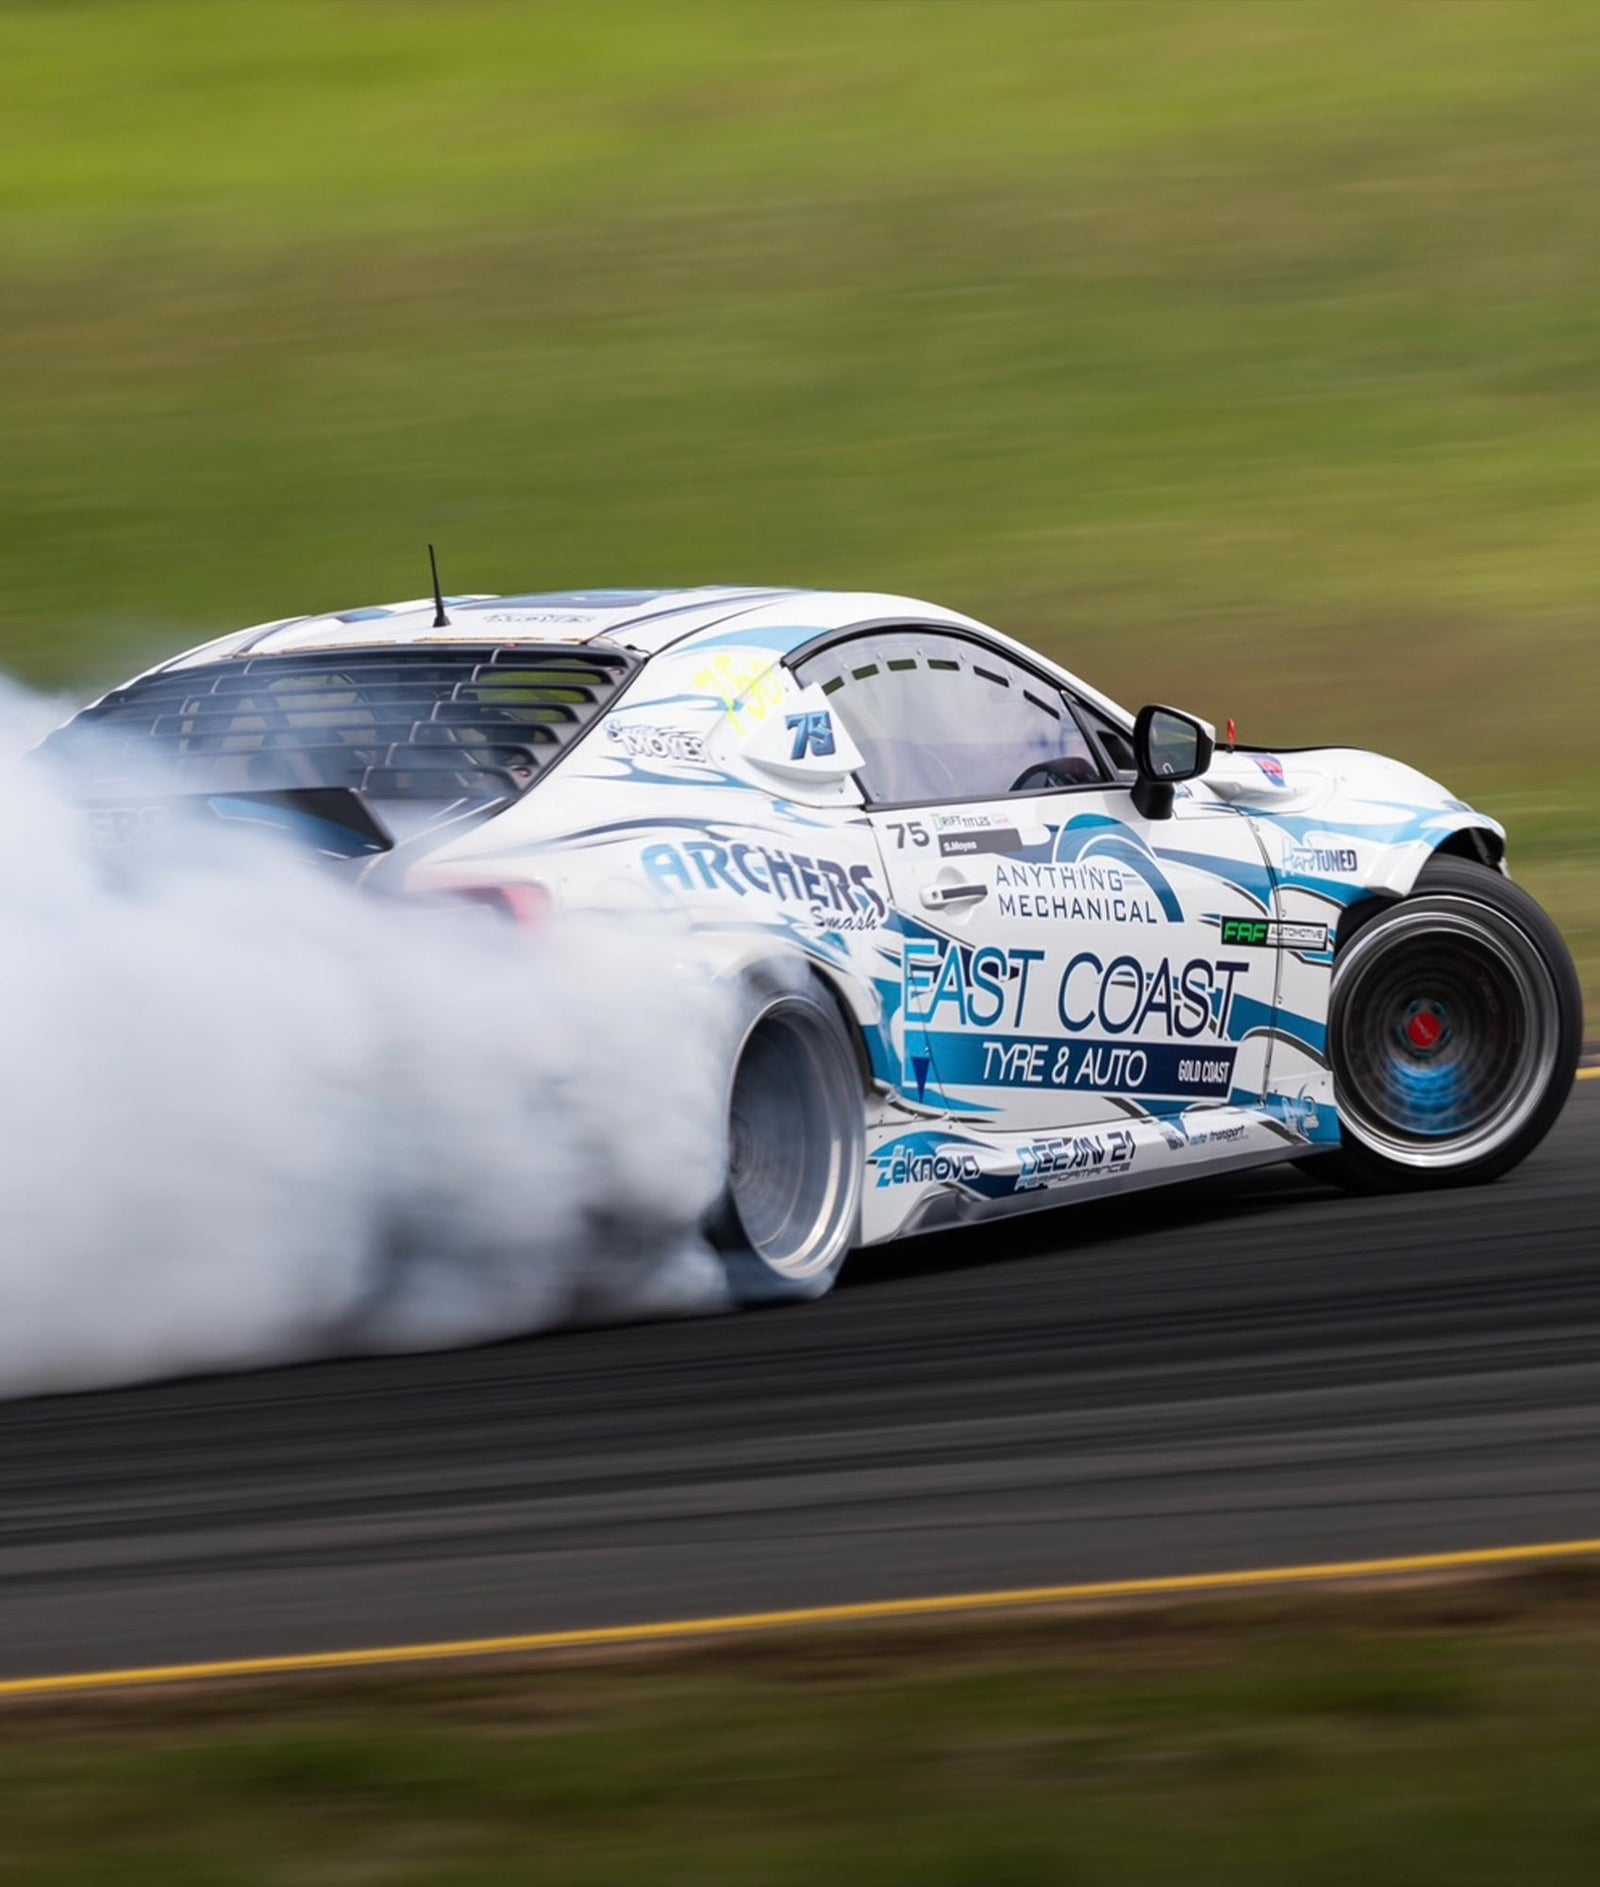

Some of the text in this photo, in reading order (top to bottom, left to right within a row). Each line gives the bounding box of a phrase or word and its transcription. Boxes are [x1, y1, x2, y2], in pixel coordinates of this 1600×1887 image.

[786, 711, 836, 760] 75
[886, 821, 930, 849] 75
[640, 841, 886, 918] ARCHERS
[995, 864, 1123, 891] ANYTHING
[810, 906, 878, 931] Smash
[998, 894, 1157, 923] MECHANICAL
[1224, 920, 1323, 942] FAF AUTOMOTIVE
[904, 941, 1250, 1039] EAST COAST
[982, 1041, 1149, 1087] TYRE & AUTO
[1178, 1060, 1230, 1083] GOLD COAST
[1107, 1130, 1136, 1161] 21
[1015, 1161, 1131, 1190] PERFORMANCE
